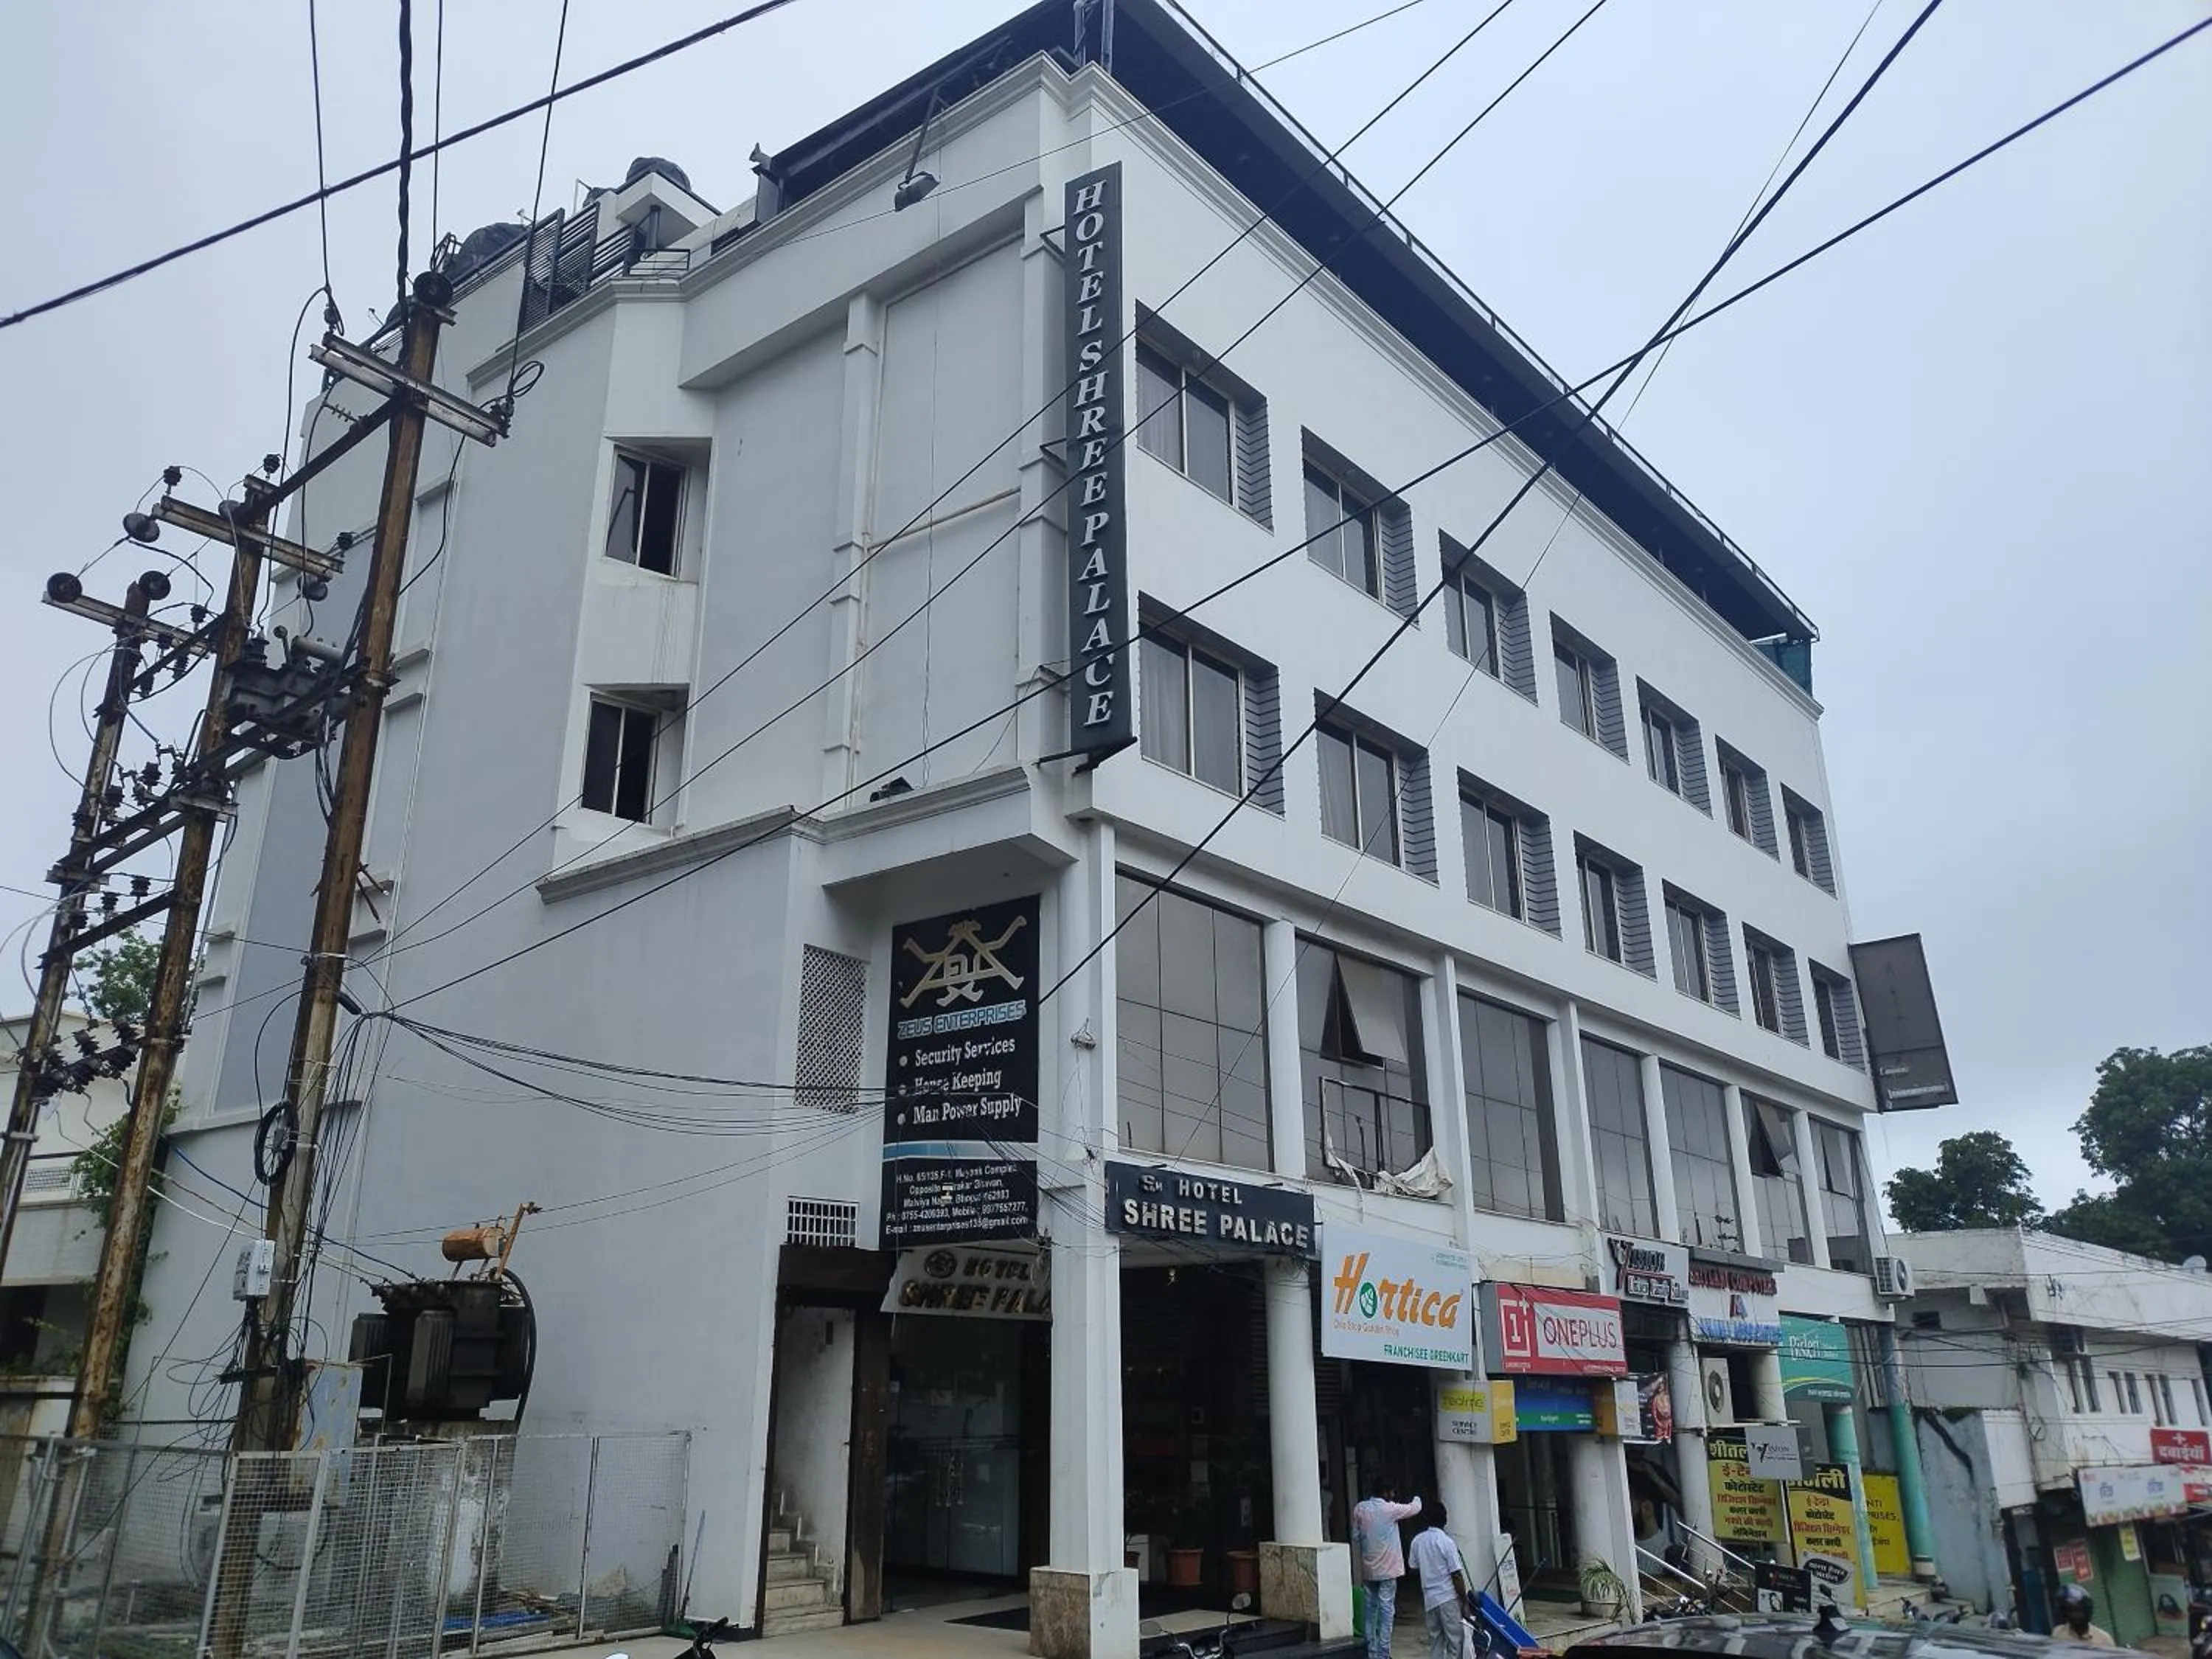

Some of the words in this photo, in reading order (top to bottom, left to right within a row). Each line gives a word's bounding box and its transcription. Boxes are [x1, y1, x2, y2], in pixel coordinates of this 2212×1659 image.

[1074, 180, 1107, 335] HOTEL
[1074, 340, 1109, 507] SHREE
[1078, 512, 1114, 727] PALACE
[897, 1017, 932, 1040] ZEUS
[934, 1000, 1027, 1032] ENTERPRISES
[915, 1044, 961, 1067] Security
[964, 1036, 1015, 1059] Services
[952, 1068, 1002, 1092] Keeping
[913, 1105, 939, 1124] Man
[980, 1091, 1023, 1119] Supply
[1179, 1179, 1242, 1205] HOTEL
[1124, 1198, 1208, 1236] SHREE
[1220, 1214, 1309, 1248] PALACE
[1333, 1251, 1463, 1329] Hortica
[1543, 1316, 1617, 1349] ONEPLUS
